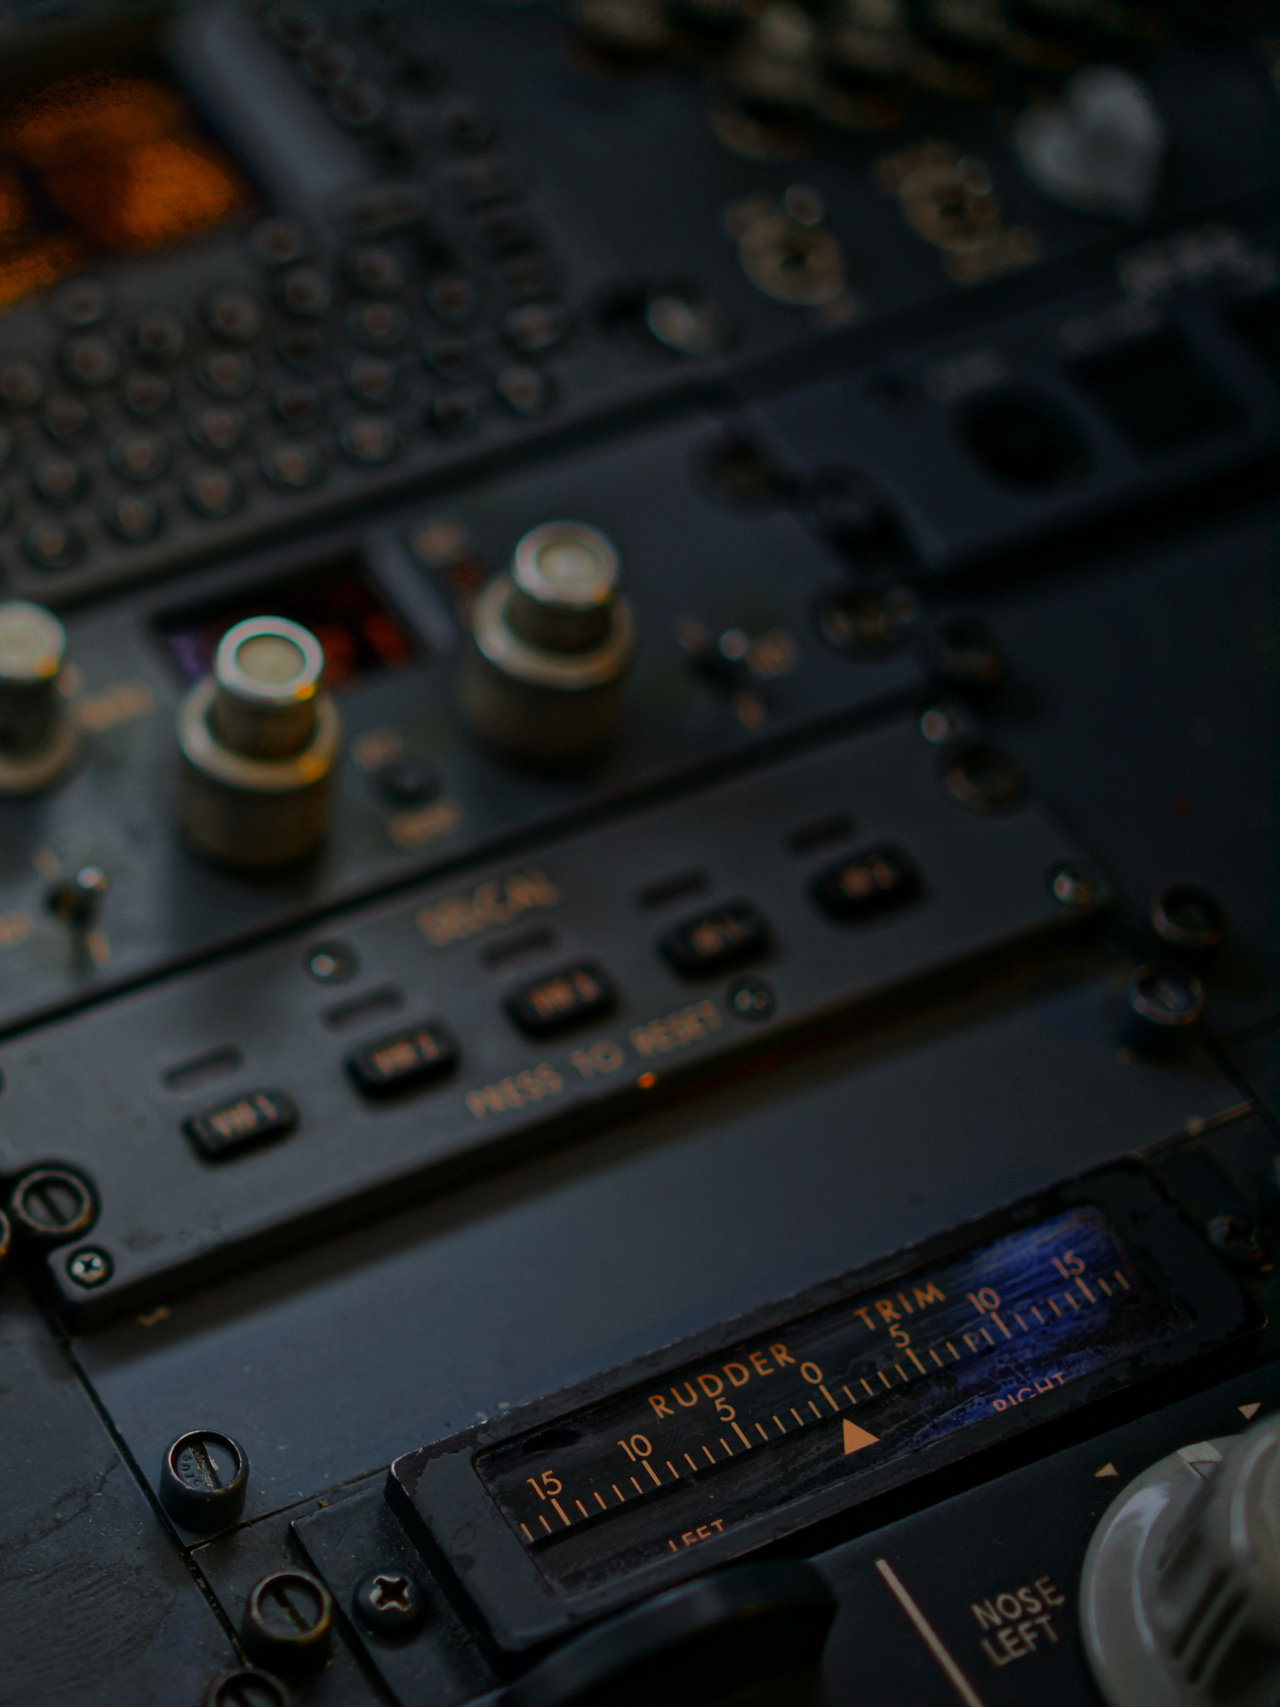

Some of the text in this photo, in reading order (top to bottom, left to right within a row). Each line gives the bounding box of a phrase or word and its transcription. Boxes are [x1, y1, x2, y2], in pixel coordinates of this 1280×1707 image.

[466, 999, 720, 1121] PRESS TO RESET
[526, 1250, 1087, 1501] 15 10 5 0 5 10 15
[647, 1281, 947, 1419] RUDDER TRIM
[970, 1574, 1066, 1631] NOSE
[981, 1612, 1060, 1668] LEFT
